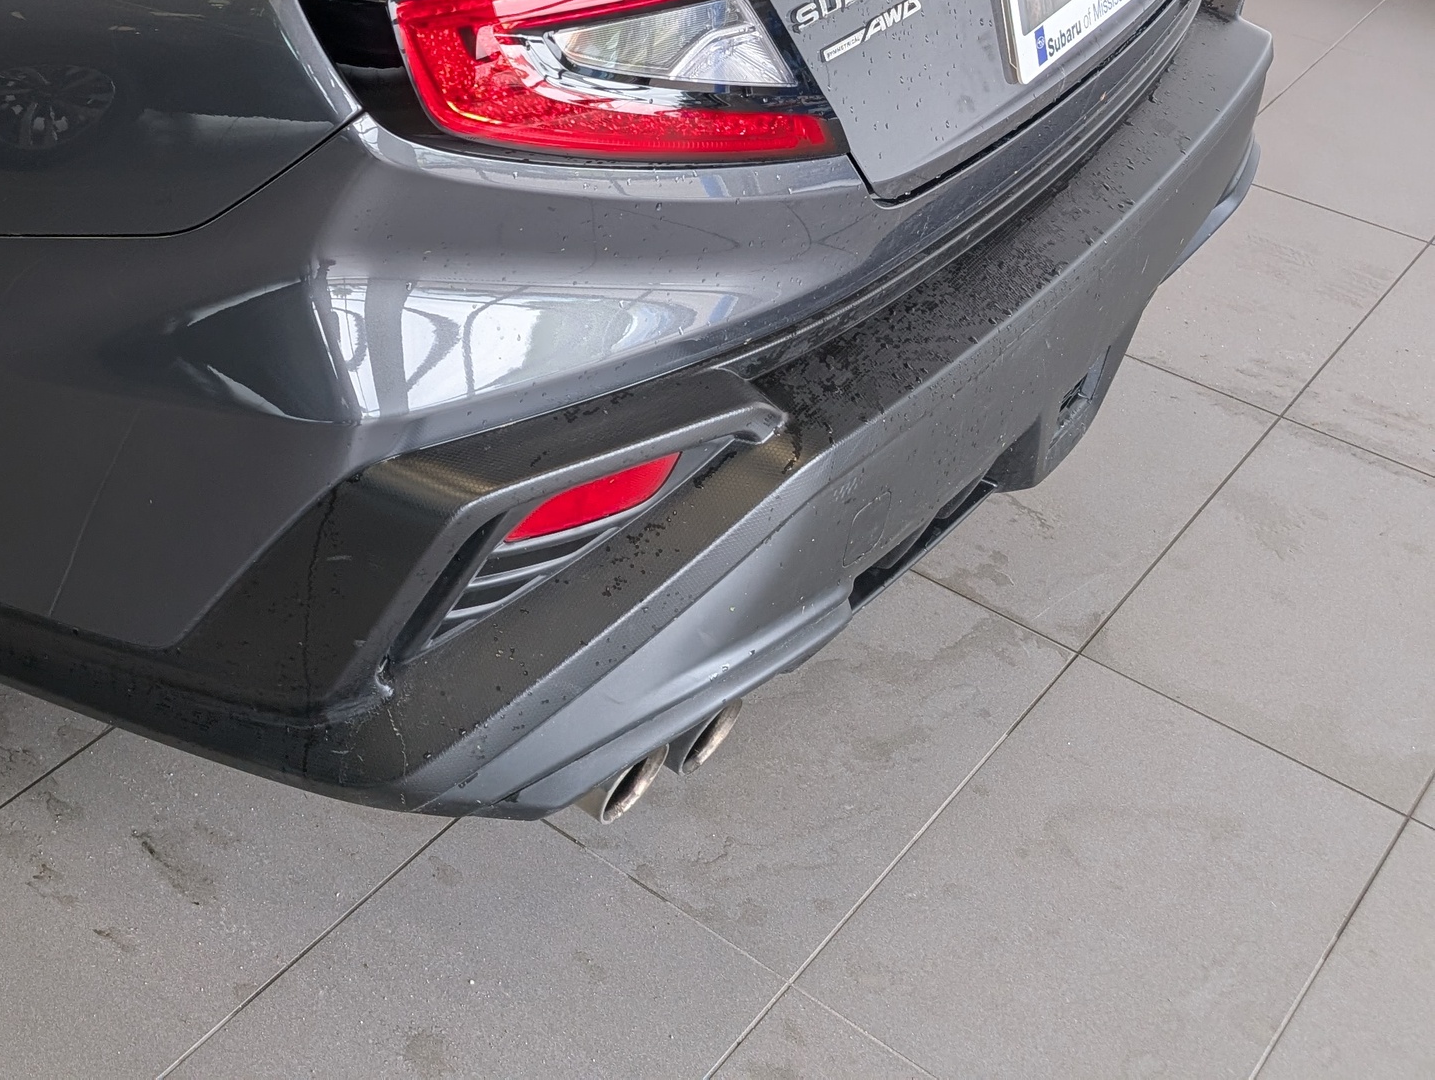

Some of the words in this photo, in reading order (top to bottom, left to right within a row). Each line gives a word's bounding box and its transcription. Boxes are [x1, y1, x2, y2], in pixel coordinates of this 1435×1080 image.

[826, 31, 864, 59] SYMMETRICAL
[1047, 20, 1082, 58] Subaru
[1083, 7, 1092, 29] of
